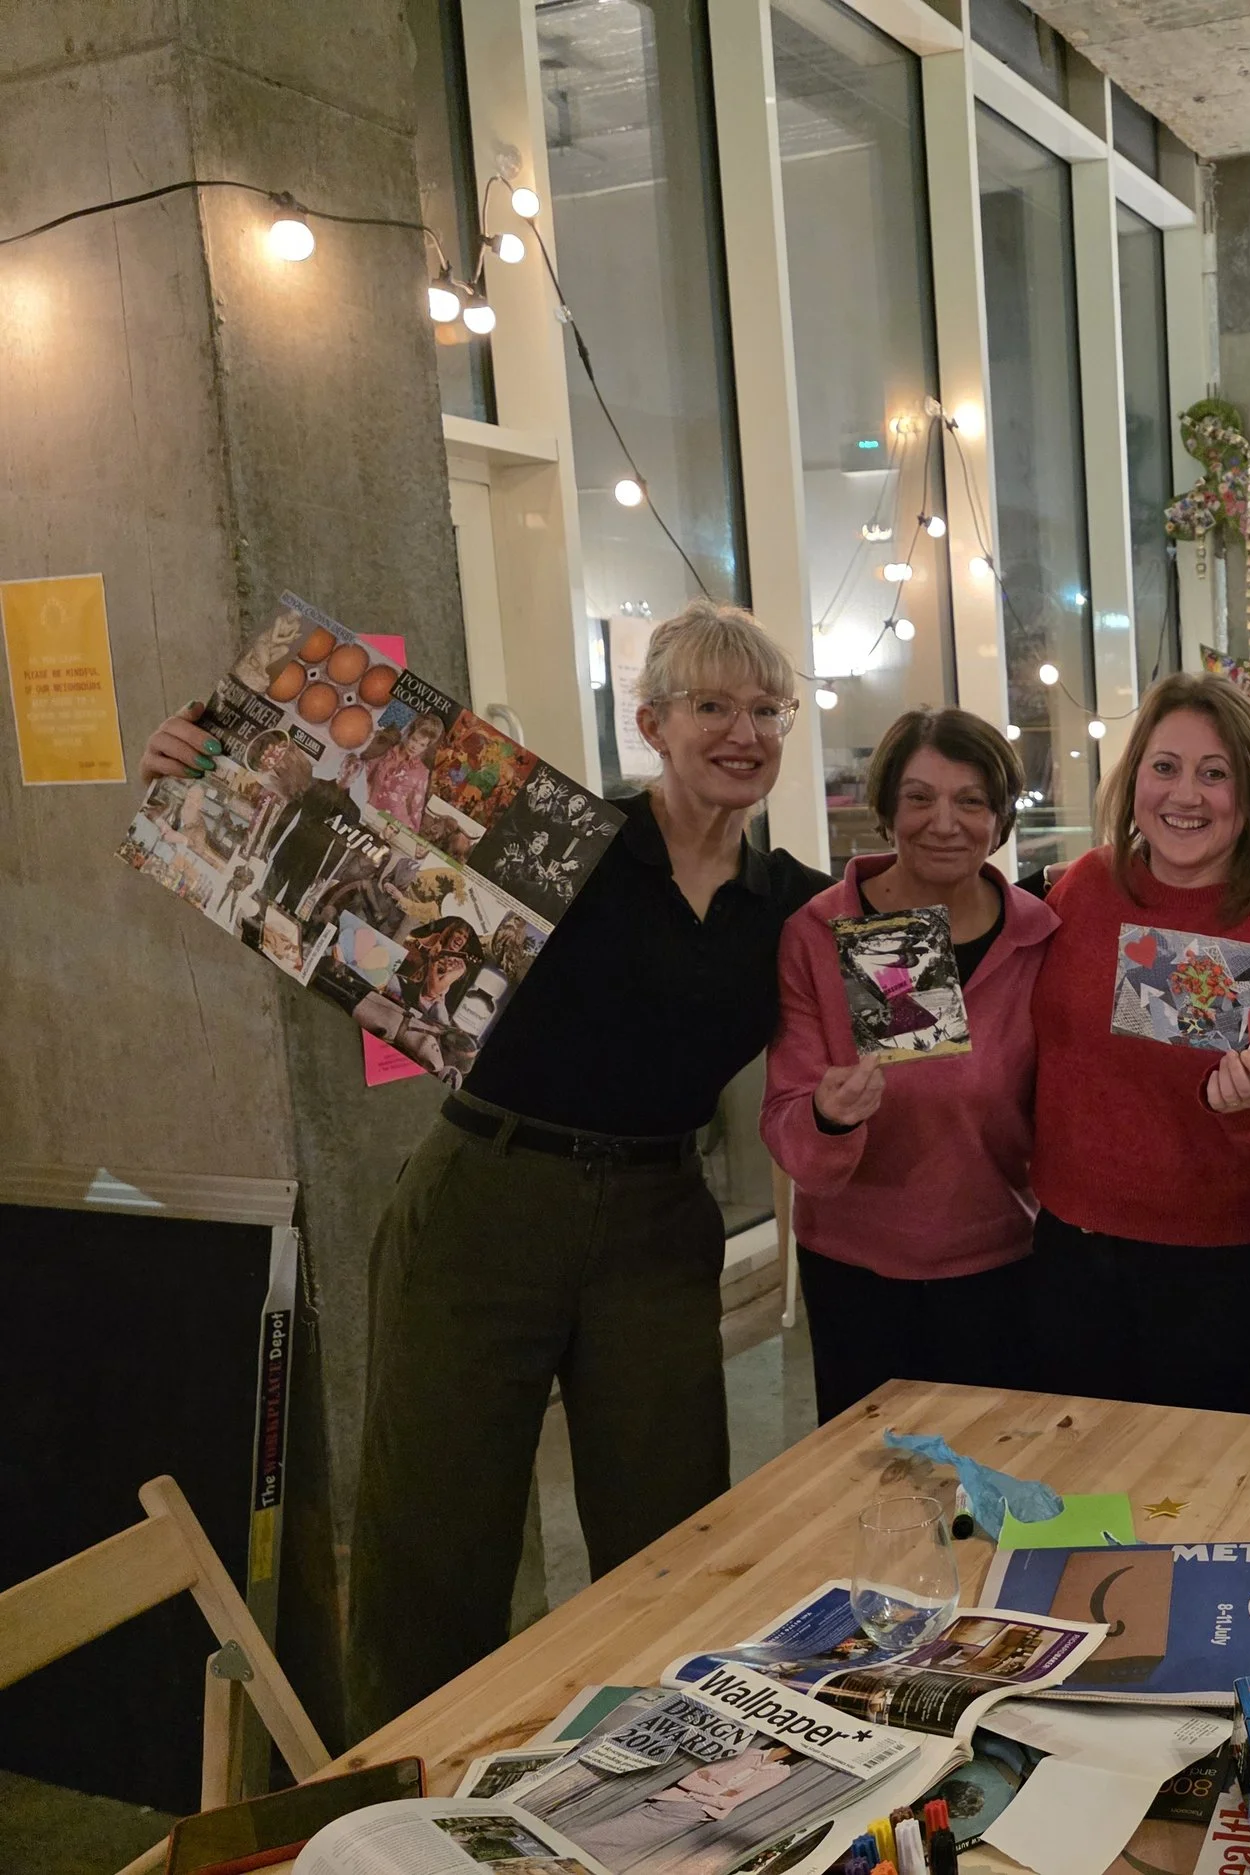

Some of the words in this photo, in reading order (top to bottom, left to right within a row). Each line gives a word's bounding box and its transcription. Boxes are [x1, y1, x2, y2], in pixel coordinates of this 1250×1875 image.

[24, 670, 50, 681] PLEASE
[52, 669, 62, 678] BE
[392, 685, 432, 715] ROOM
[400, 673, 453, 713] POWDER
[241, 696, 283, 731] TICKETS
[237, 720, 257, 741] BE
[324, 813, 391, 868] Artful
[269, 1312, 286, 1360] Depot
[261, 1476, 277, 1506] The
[1210, 1623, 1232, 1646] July
[637, 1714, 739, 1763] AWARDS
[663, 1699, 754, 1746] DESIGN
[614, 1729, 667, 1758] 2016
